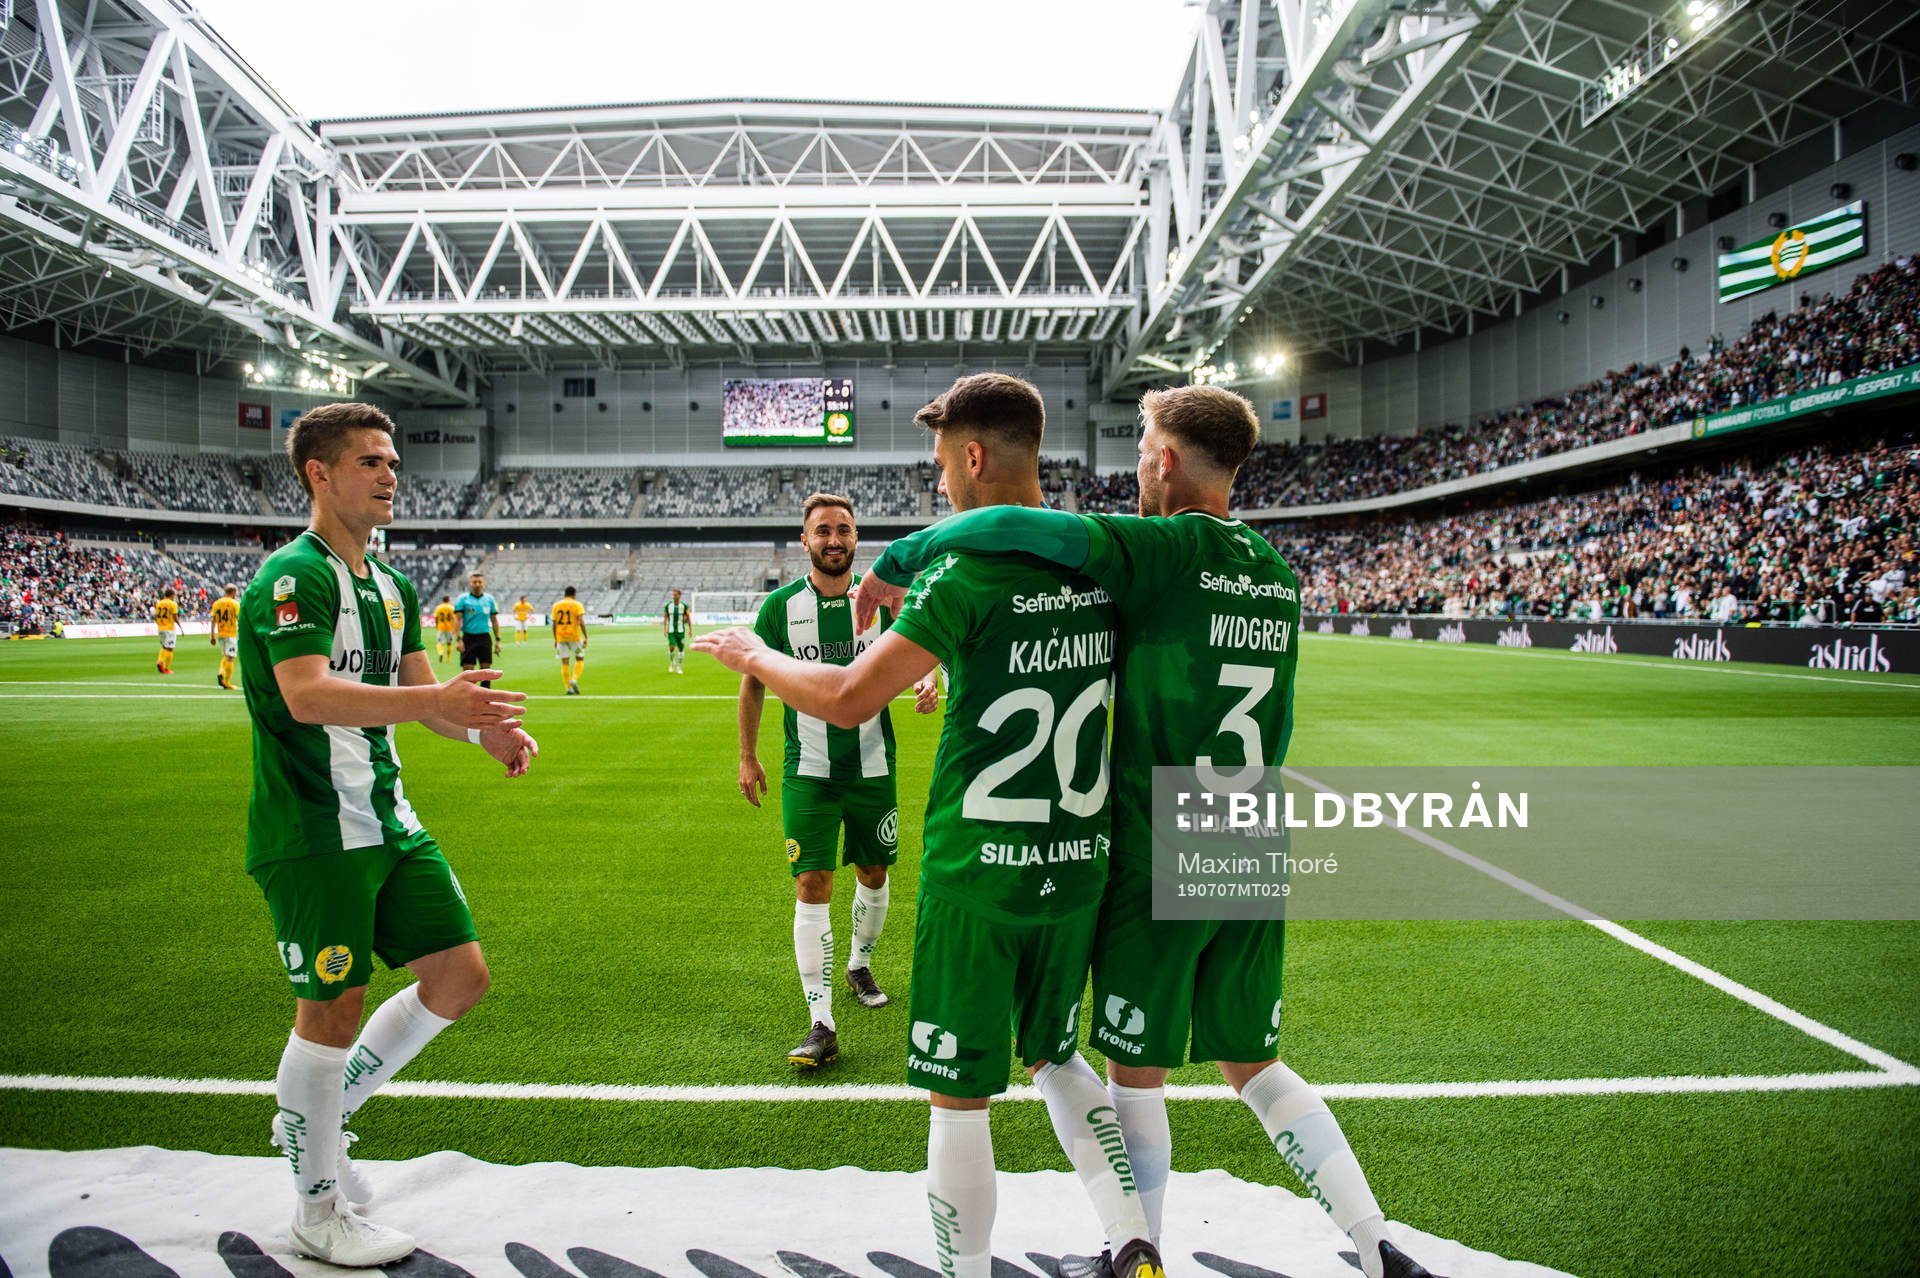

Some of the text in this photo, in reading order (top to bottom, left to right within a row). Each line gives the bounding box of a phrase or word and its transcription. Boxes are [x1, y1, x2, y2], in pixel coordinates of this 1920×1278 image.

[1854, 375, 1904, 396] RESPEKT
[443, 433, 475, 444] Arena
[1200, 571, 1243, 596] Sefina
[156, 606, 169, 619] 22
[1012, 586, 1112, 614] Sefina pantb
[216, 609, 229, 622] 14
[557, 610, 571, 625] 21
[1209, 614, 1291, 653] WIDGREN
[1570, 625, 1618, 655] astrids
[1672, 628, 1731, 662] astrids
[1008, 627, 1116, 674] KAČANIKLI
[1808, 633, 1890, 672] astrids
[1195, 663, 1276, 797] 3
[962, 678, 1111, 823] 20
[980, 839, 1092, 867] SILJA LINE
[1086, 1105, 1137, 1193] Clinton
[1274, 1130, 1333, 1214] Clinton
